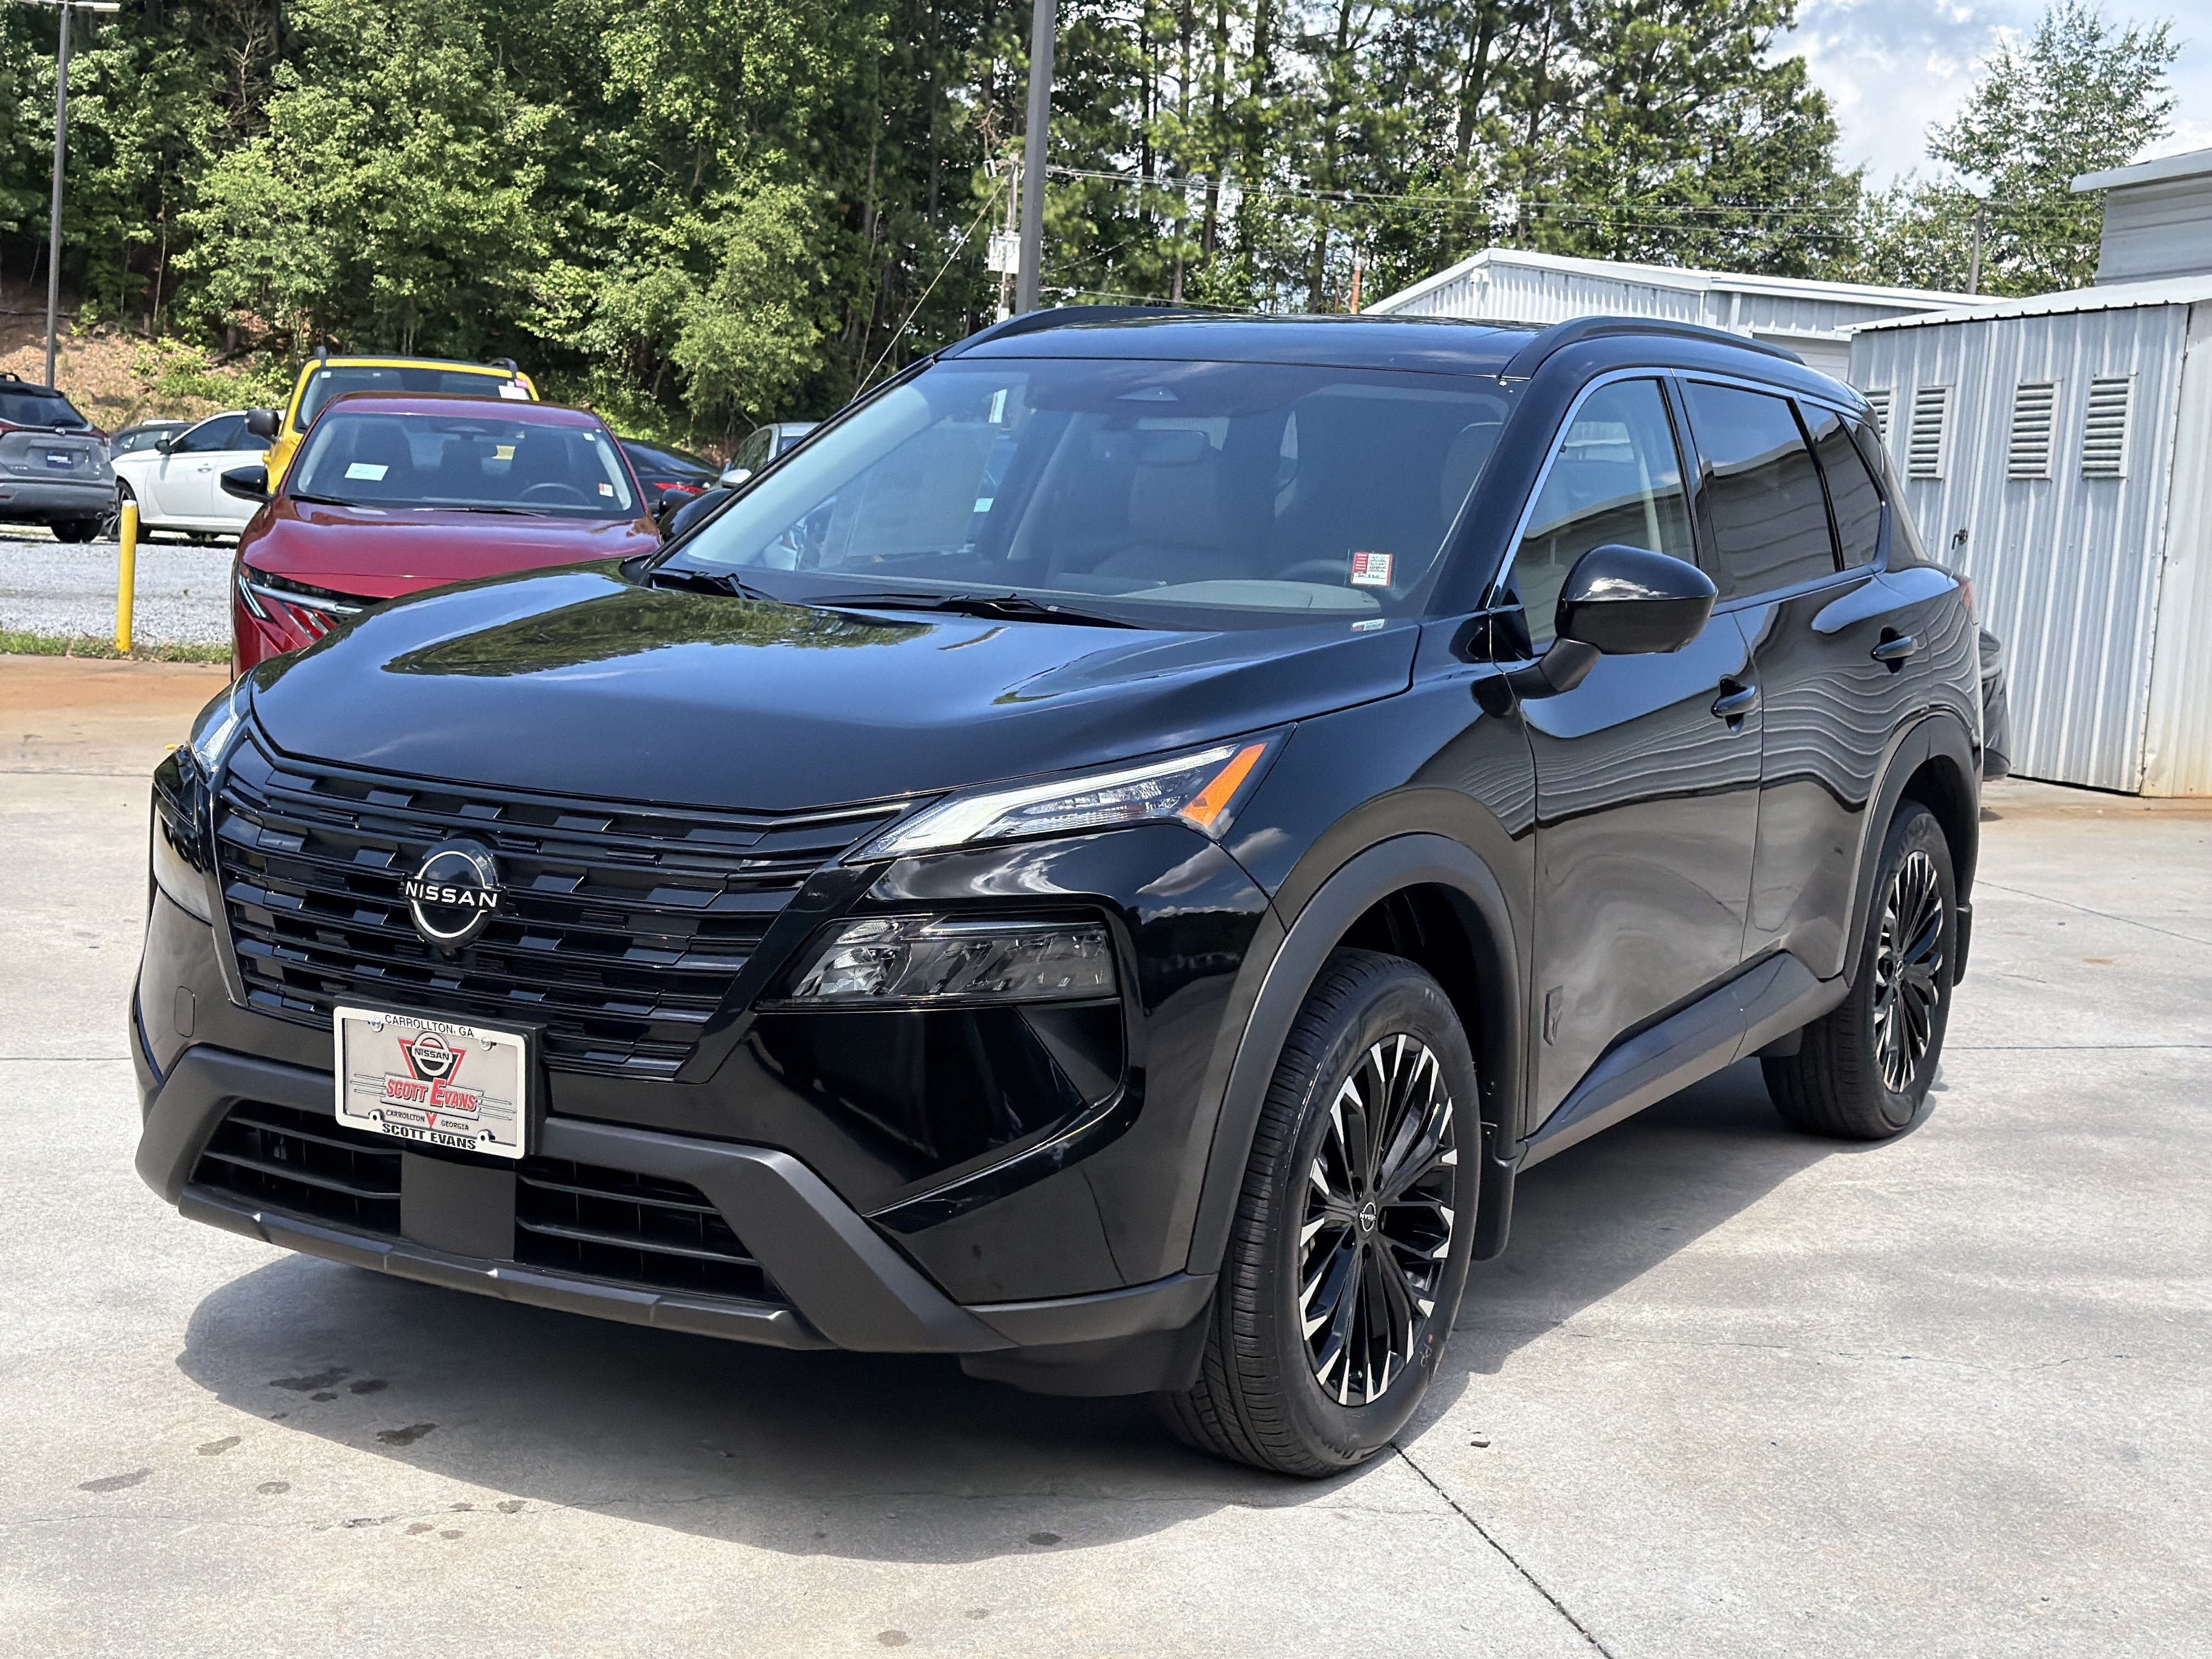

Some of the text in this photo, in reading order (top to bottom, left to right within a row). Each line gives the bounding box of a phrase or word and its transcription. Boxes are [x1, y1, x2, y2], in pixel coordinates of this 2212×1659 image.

[405, 881, 498, 907] NISSAN
[385, 1014, 475, 1037] CARROLLTON, GA
[415, 1048, 449, 1060] NISSAN
[386, 1079, 428, 1102] SCOTT
[386, 1110, 469, 1131] CARROLLTON GEORGIA
[382, 1123, 476, 1150] SCOTT EVANS
